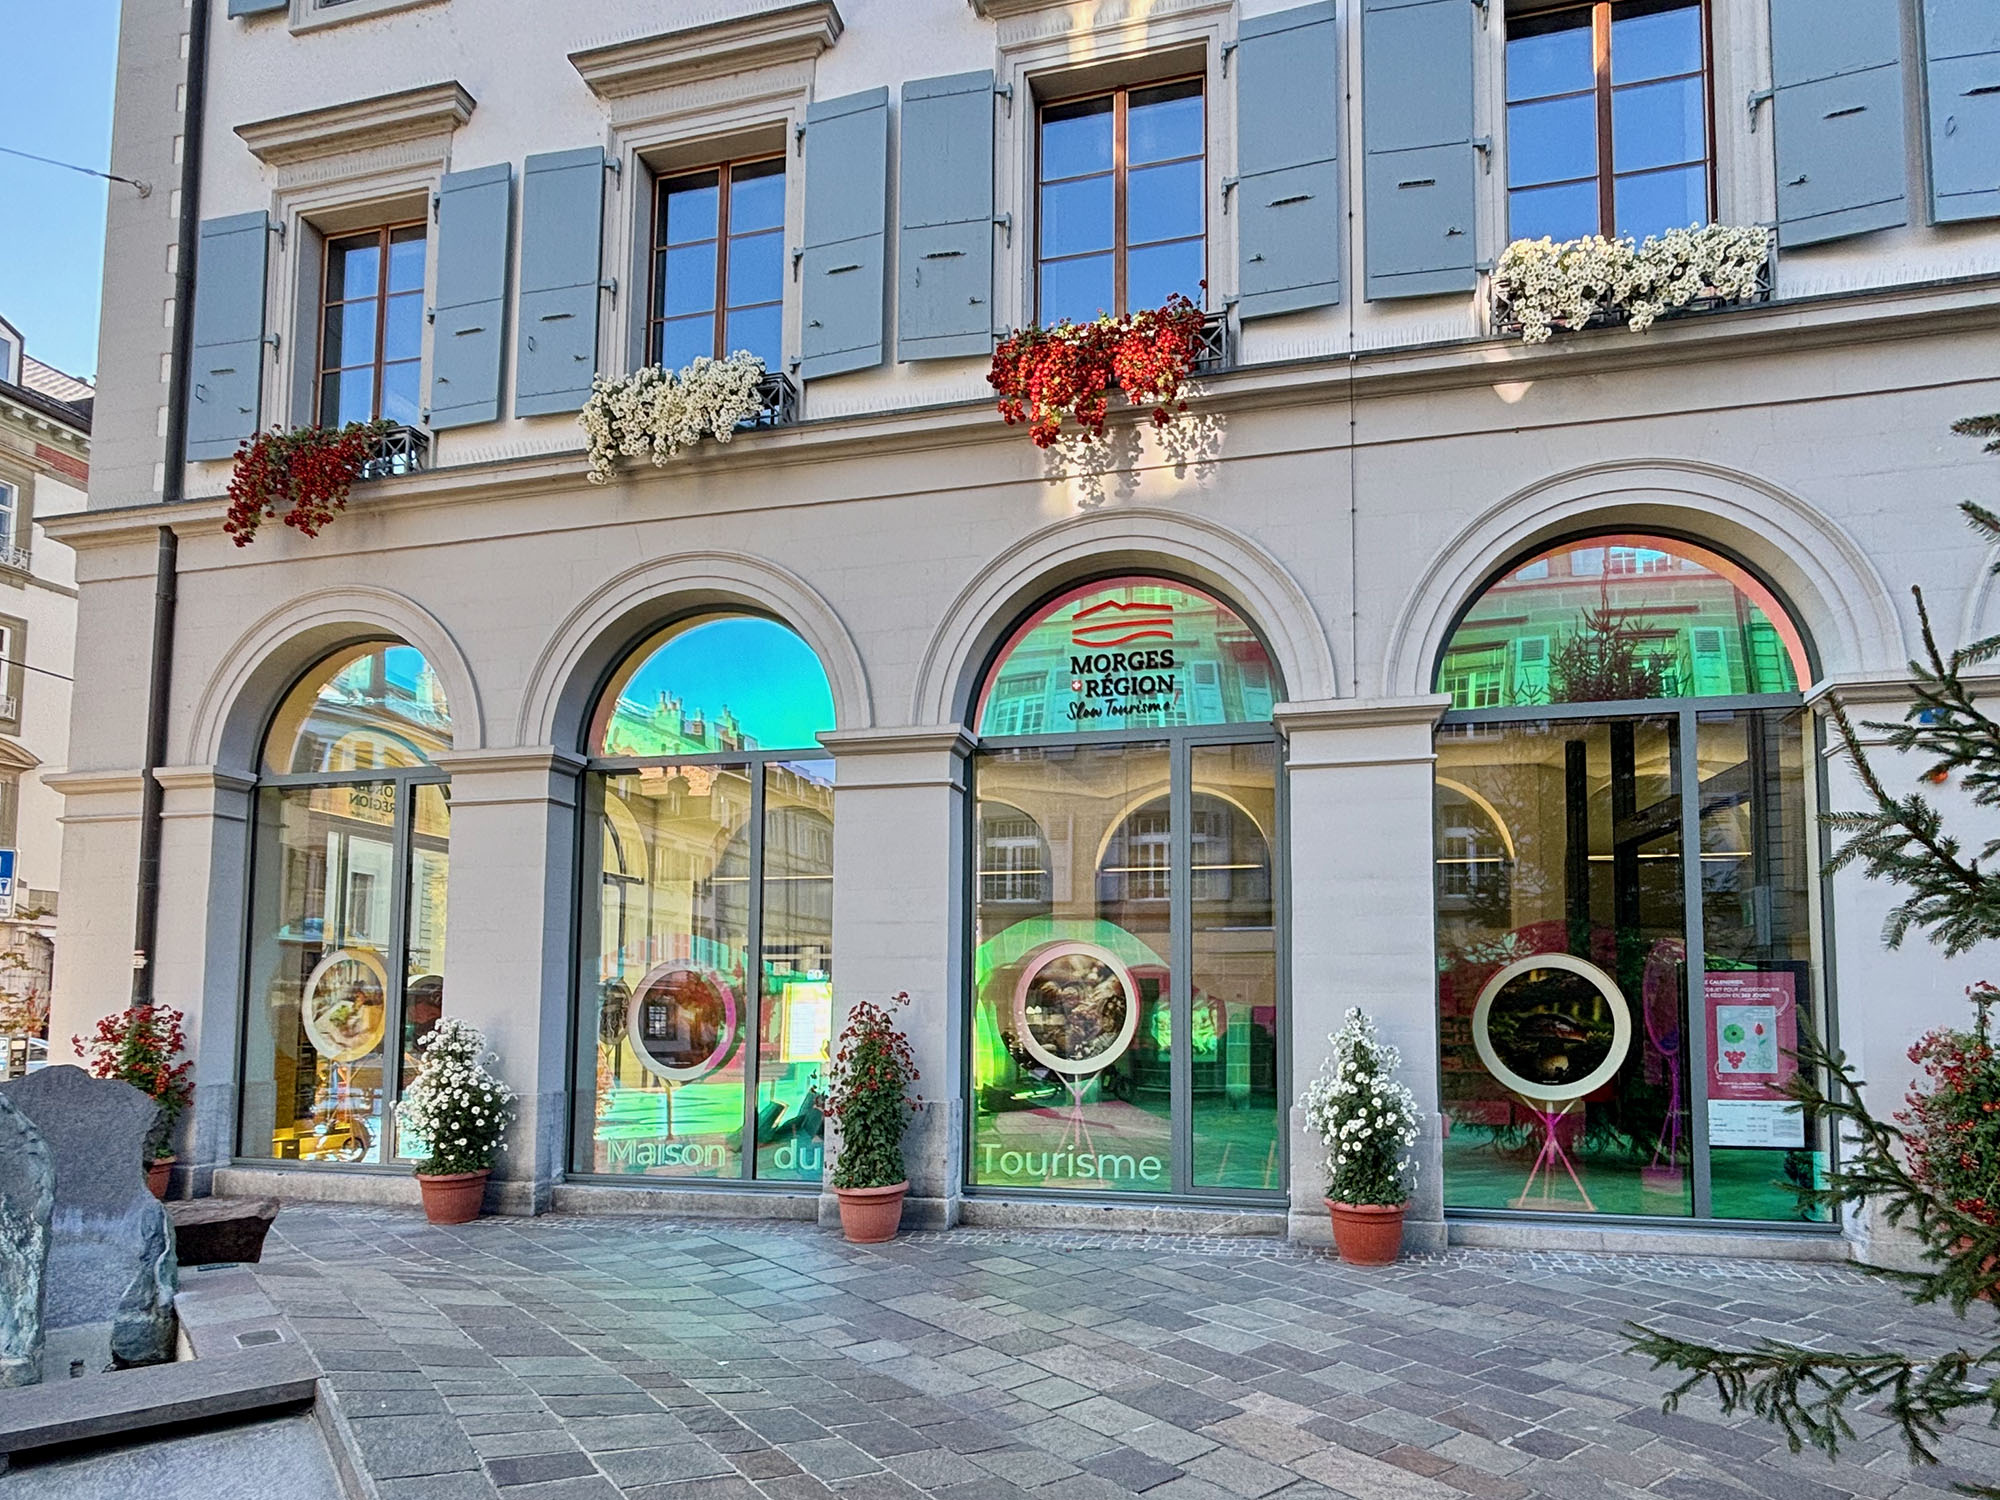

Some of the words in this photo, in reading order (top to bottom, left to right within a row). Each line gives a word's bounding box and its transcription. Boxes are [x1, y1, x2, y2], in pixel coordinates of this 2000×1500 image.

[1070, 649, 1174, 674] MORGES
[1085, 672, 1175, 698] RÉGION
[1066, 701, 1102, 721] Slow
[607, 1138, 726, 1168] Maison
[774, 1138, 821, 1170] du
[979, 1143, 1162, 1181] Tourisme
